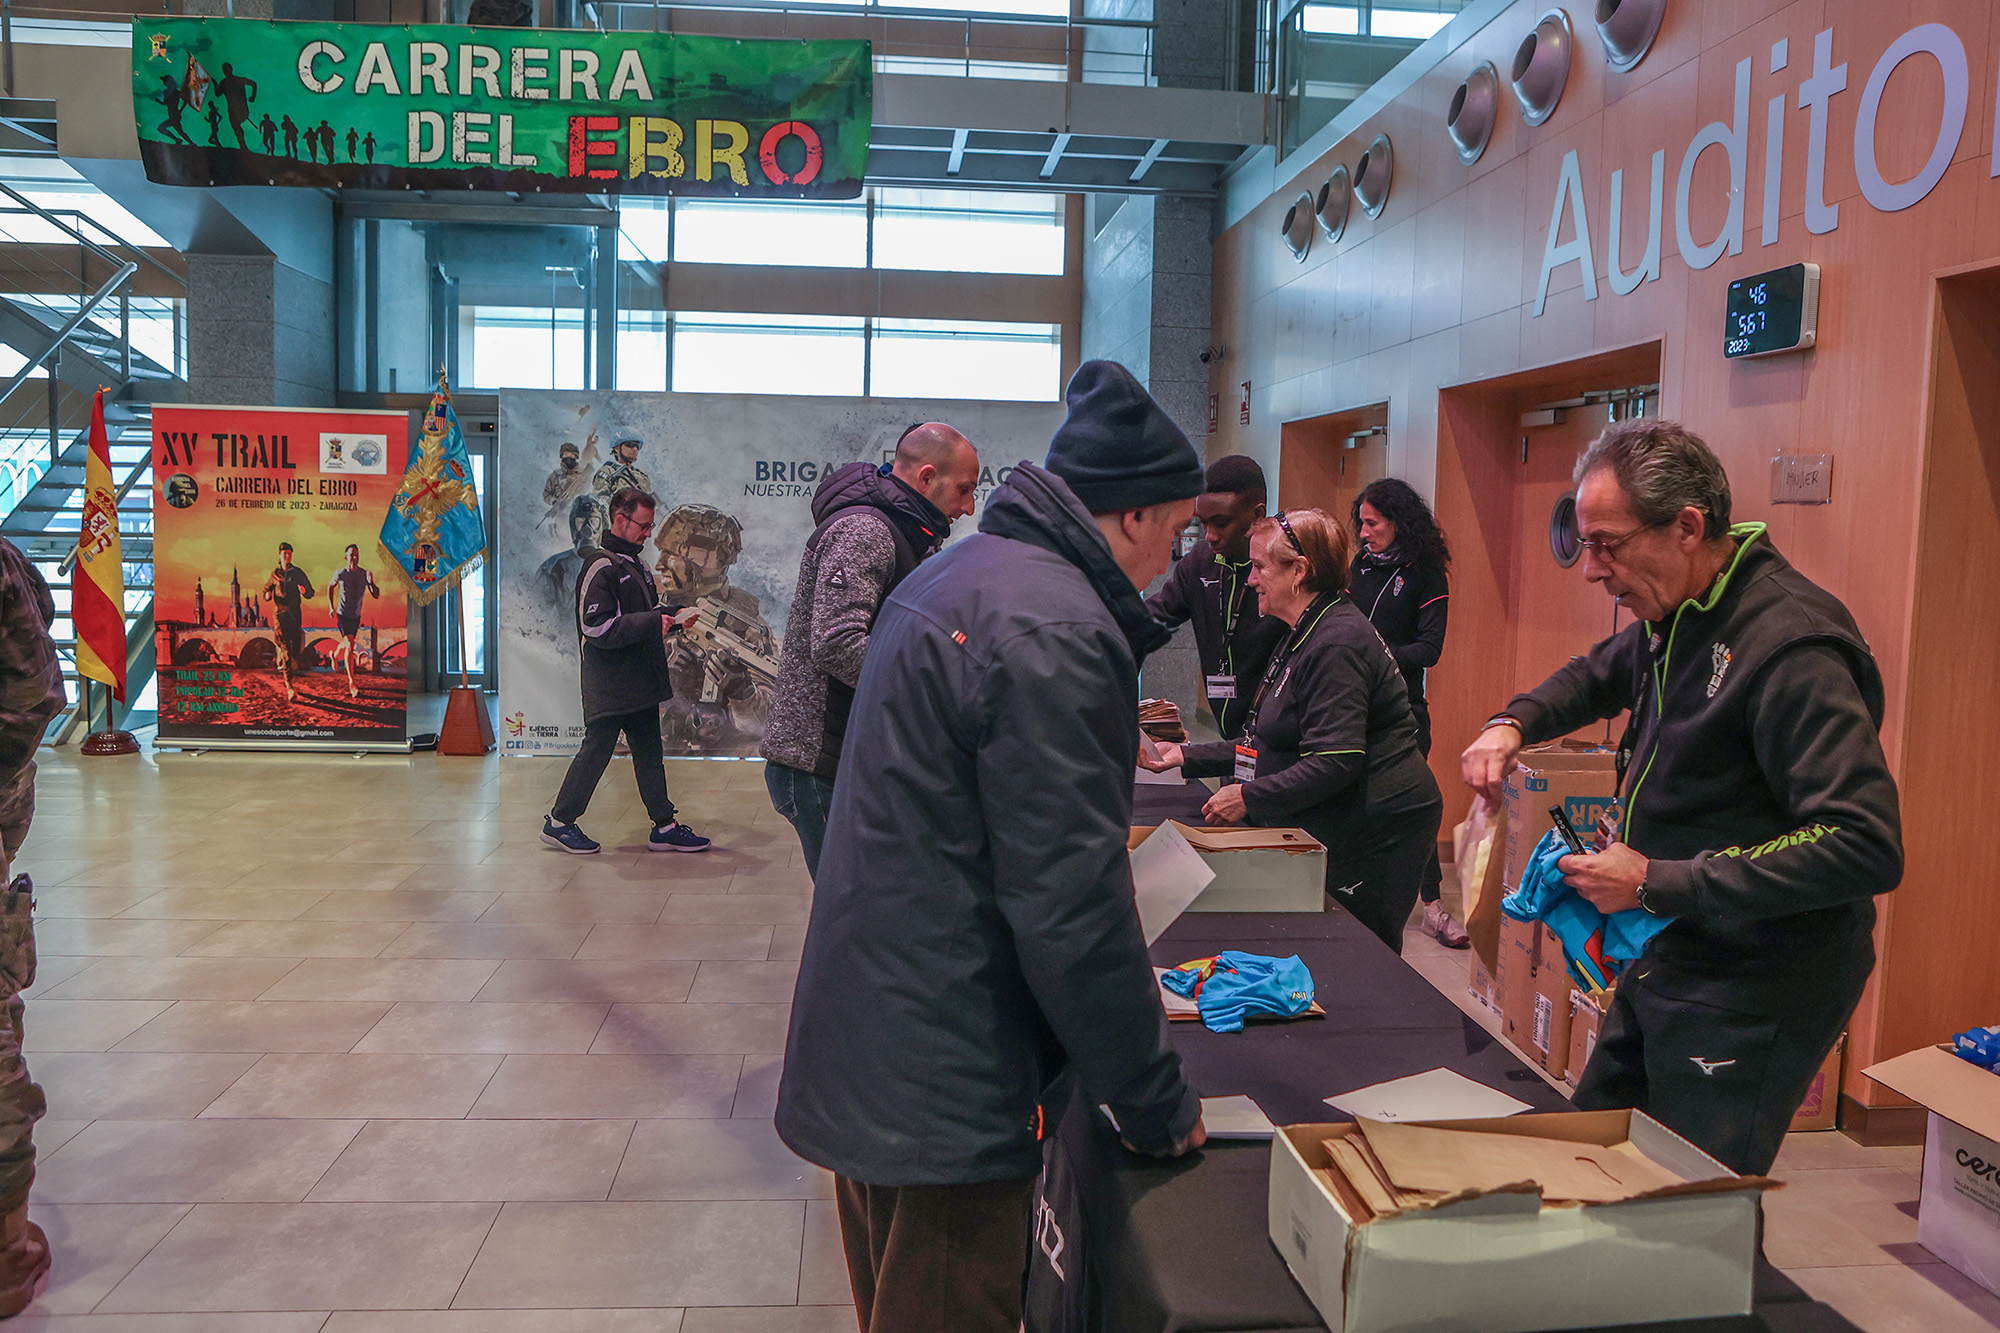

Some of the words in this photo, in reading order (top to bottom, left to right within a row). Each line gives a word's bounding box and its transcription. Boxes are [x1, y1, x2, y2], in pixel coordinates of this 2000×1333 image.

[298, 40, 654, 101] CARRERA
[407, 111, 538, 166] DEL
[568, 116, 823, 186] EBRO
[1533, 23, 2000, 318] Audito
[1749, 282, 1767, 305] 46
[1738, 310, 1766, 336] 567
[1728, 338, 1749, 353] 2023
[161, 432, 198, 465] XV
[212, 433, 296, 469] TRAIL
[756, 461, 848, 482] BRIGA
[1786, 470, 1819, 488] MUJER
[216, 476, 281, 494] CARRERA
[287, 478, 313, 495] DEL
[320, 479, 357, 496] EBRO
[744, 484, 813, 497] NUESTRA
[215, 499, 226, 508] 26
[229, 499, 238, 508] DE
[241, 499, 274, 509] FEBRERO
[277, 500, 286, 509] DE
[289, 501, 310, 510] 2023
[320, 502, 358, 511] ZARAGOZA
[176, 670, 199, 680] TRAIL
[203, 671, 215, 681] 25
